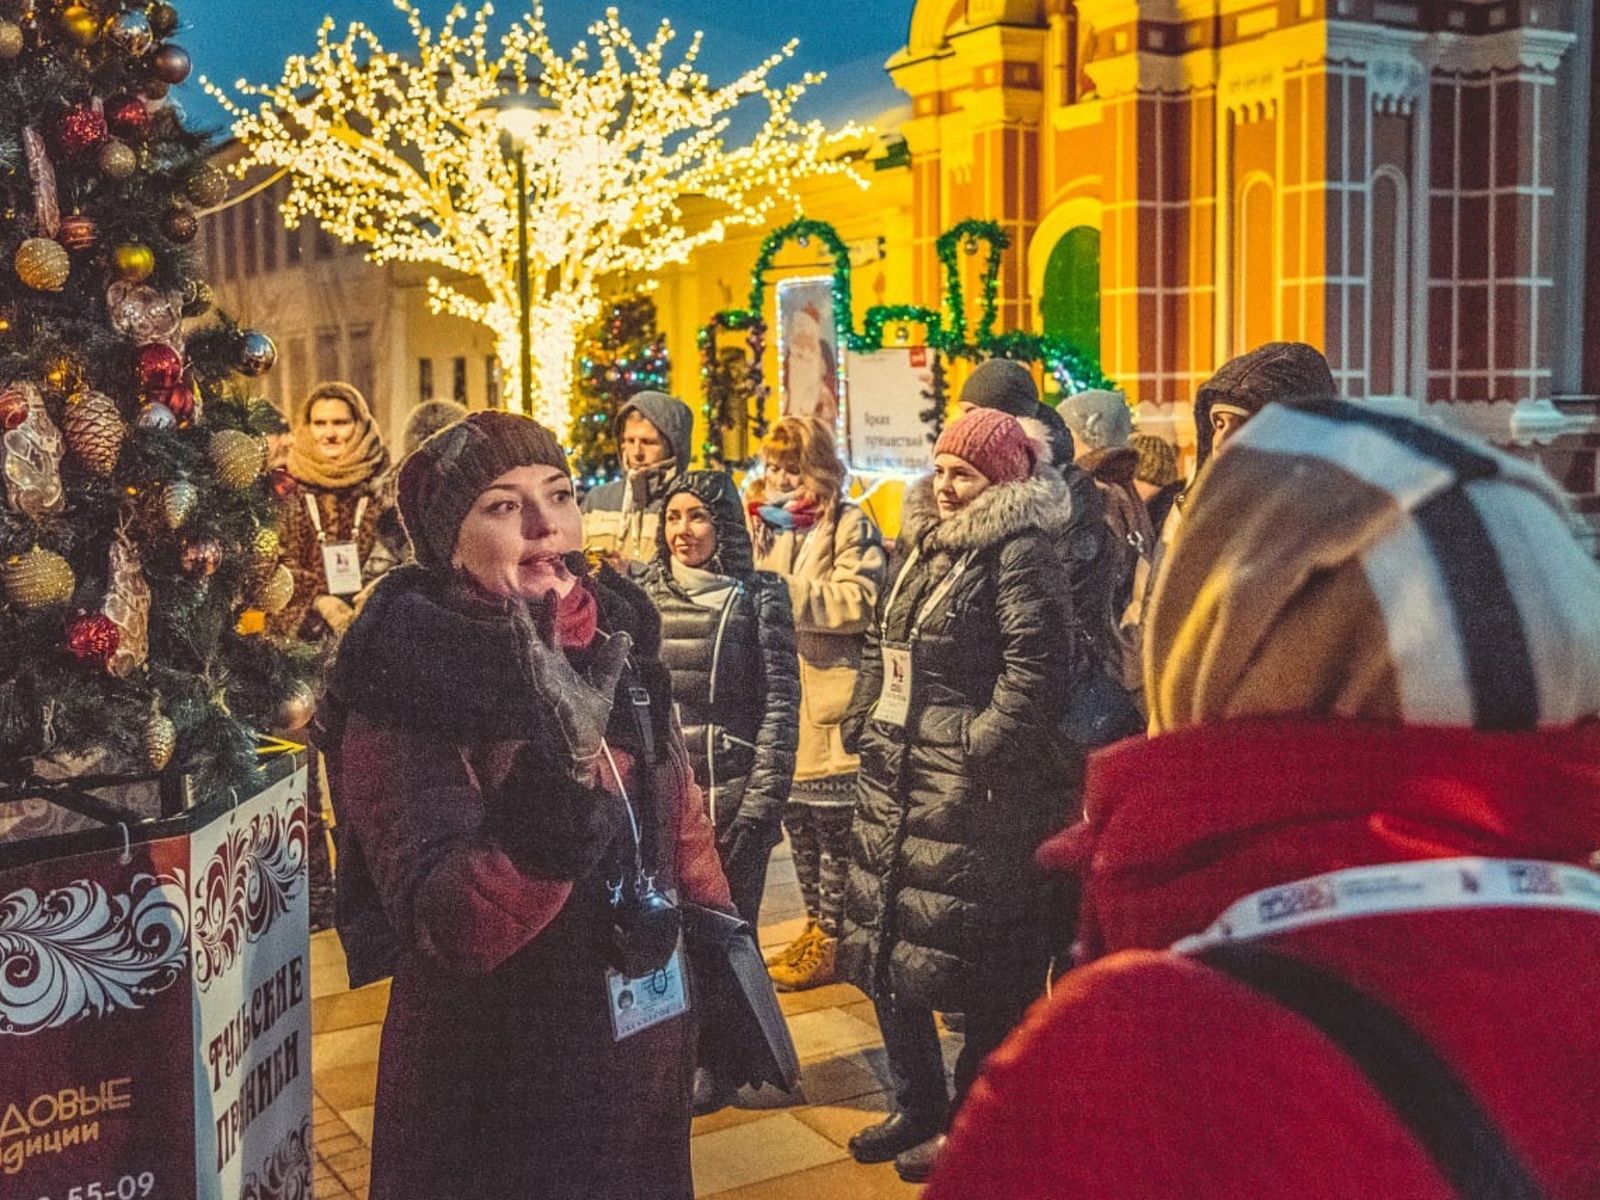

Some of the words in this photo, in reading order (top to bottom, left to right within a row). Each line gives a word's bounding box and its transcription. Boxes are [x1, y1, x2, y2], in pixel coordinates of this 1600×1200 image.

[209, 955, 303, 1092] ТУЛЬСКИЕ
[0, 1121, 100, 1175] диции
[216, 1030, 299, 1174] ПРЯНИКИ
